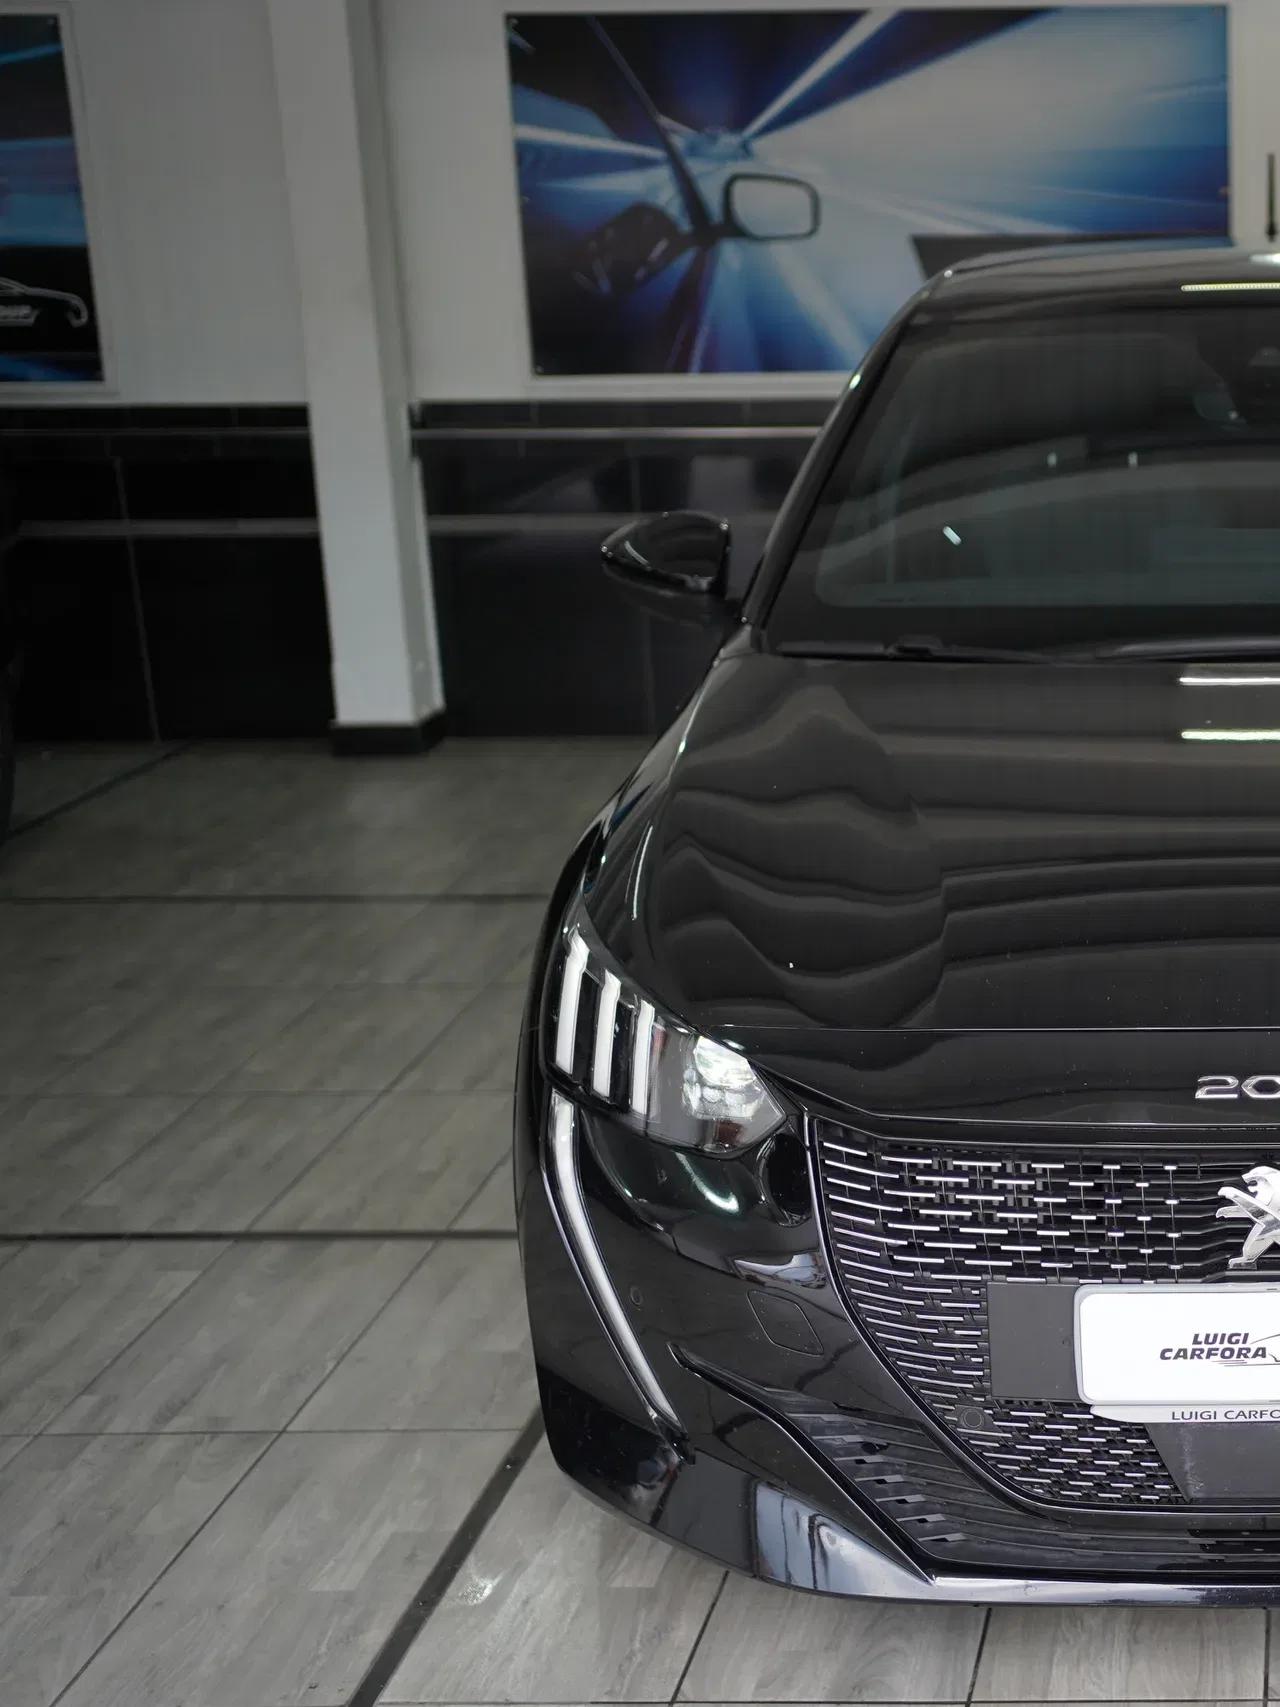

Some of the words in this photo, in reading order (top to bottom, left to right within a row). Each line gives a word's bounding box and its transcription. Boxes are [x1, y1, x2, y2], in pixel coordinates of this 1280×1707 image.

[1191, 1332, 1249, 1346] LUIGI
[1159, 1346, 1267, 1361] CARFORA
[1171, 1410, 1218, 1421] LUIGI
